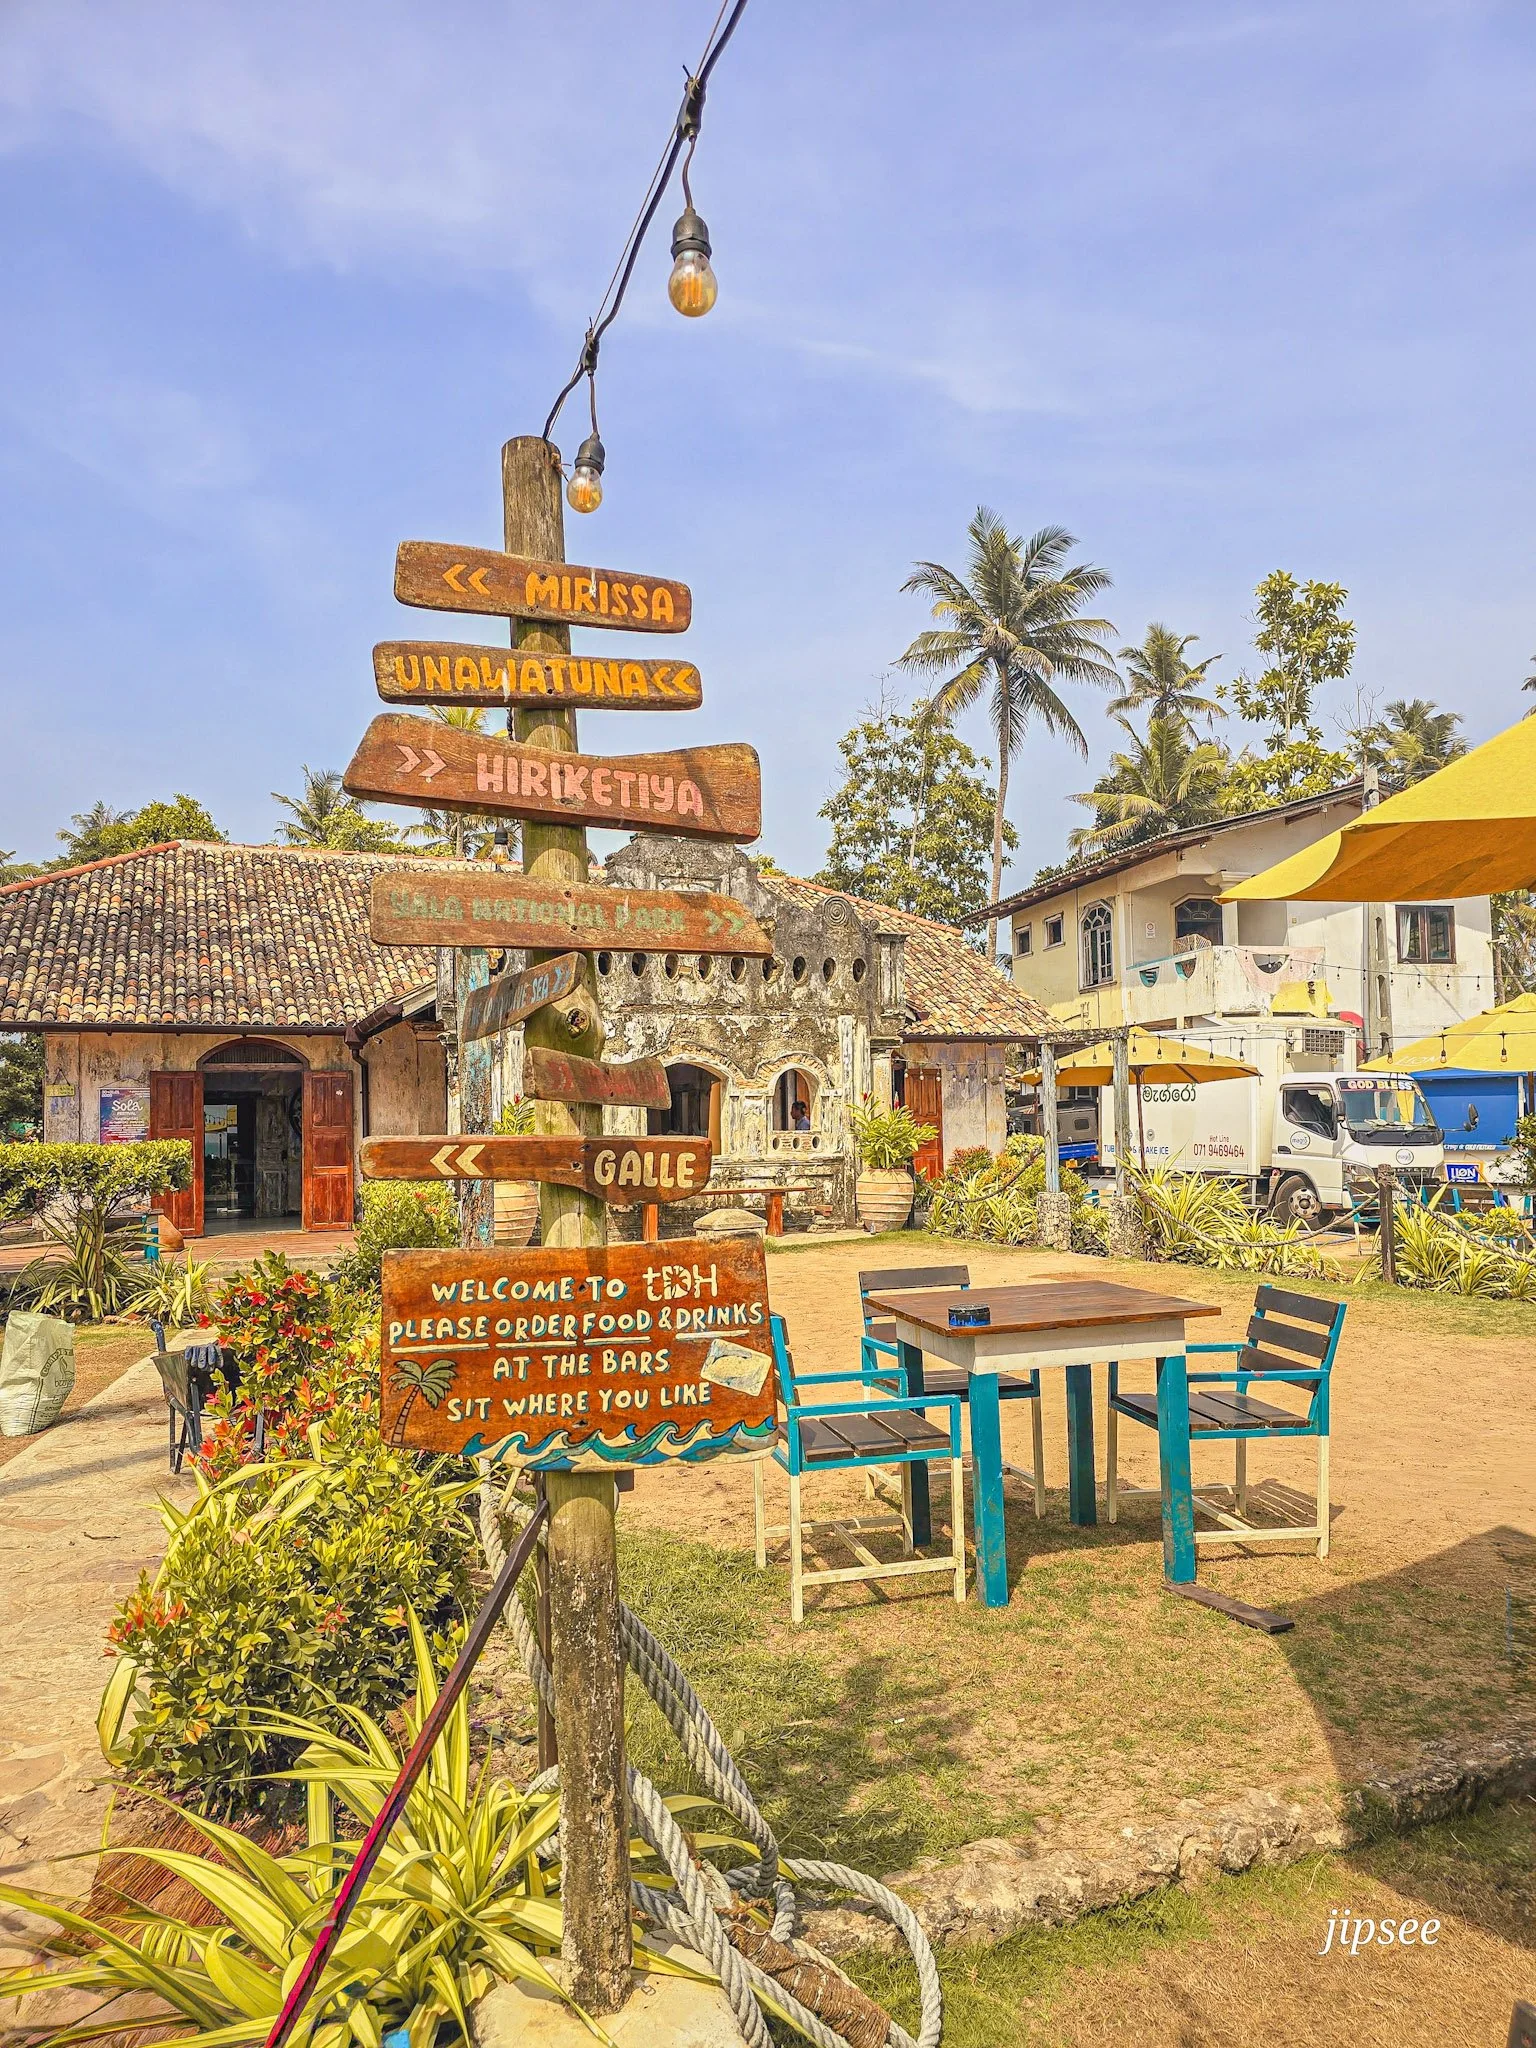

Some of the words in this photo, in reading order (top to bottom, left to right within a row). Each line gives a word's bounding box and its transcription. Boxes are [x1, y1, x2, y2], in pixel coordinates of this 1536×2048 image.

[525, 572, 674, 623] MIRISSA
[394, 655, 649, 696] UNAWATUNA
[476, 752, 704, 817] HIRIKETIYA
[390, 888, 463, 920] YALA
[472, 896, 608, 929] NATIONAL
[614, 904, 686, 930] PARK
[1347, 1080, 1374, 1090] GOD
[1377, 1080, 1413, 1091] BLESS
[1104, 1144, 1115, 1153] TUB
[1139, 1147, 1158, 1155] FAKE
[1159, 1147, 1169, 1155] ICE
[1193, 1144, 1206, 1156] 071
[1208, 1145, 1245, 1158] 9469464
[1209, 1134, 1217, 1143] Hot
[1219, 1135, 1230, 1143] Line
[594, 1149, 697, 1188] GALLE
[431, 1276, 574, 1302] WELCOME
[586, 1276, 628, 1301] TO
[388, 1315, 489, 1345] PLEASE
[495, 1313, 578, 1341] ORDER
[582, 1309, 652, 1335] FOOD
[658, 1306, 673, 1330] &
[676, 1302, 764, 1330] DRINKS
[493, 1356, 531, 1381] AT
[542, 1353, 592, 1379] THE
[602, 1349, 671, 1375] BARS
[447, 1397, 493, 1423] SIT
[503, 1390, 588, 1417] WHERE
[599, 1389, 650, 1413] YOU
[660, 1382, 712, 1407] LIKE
